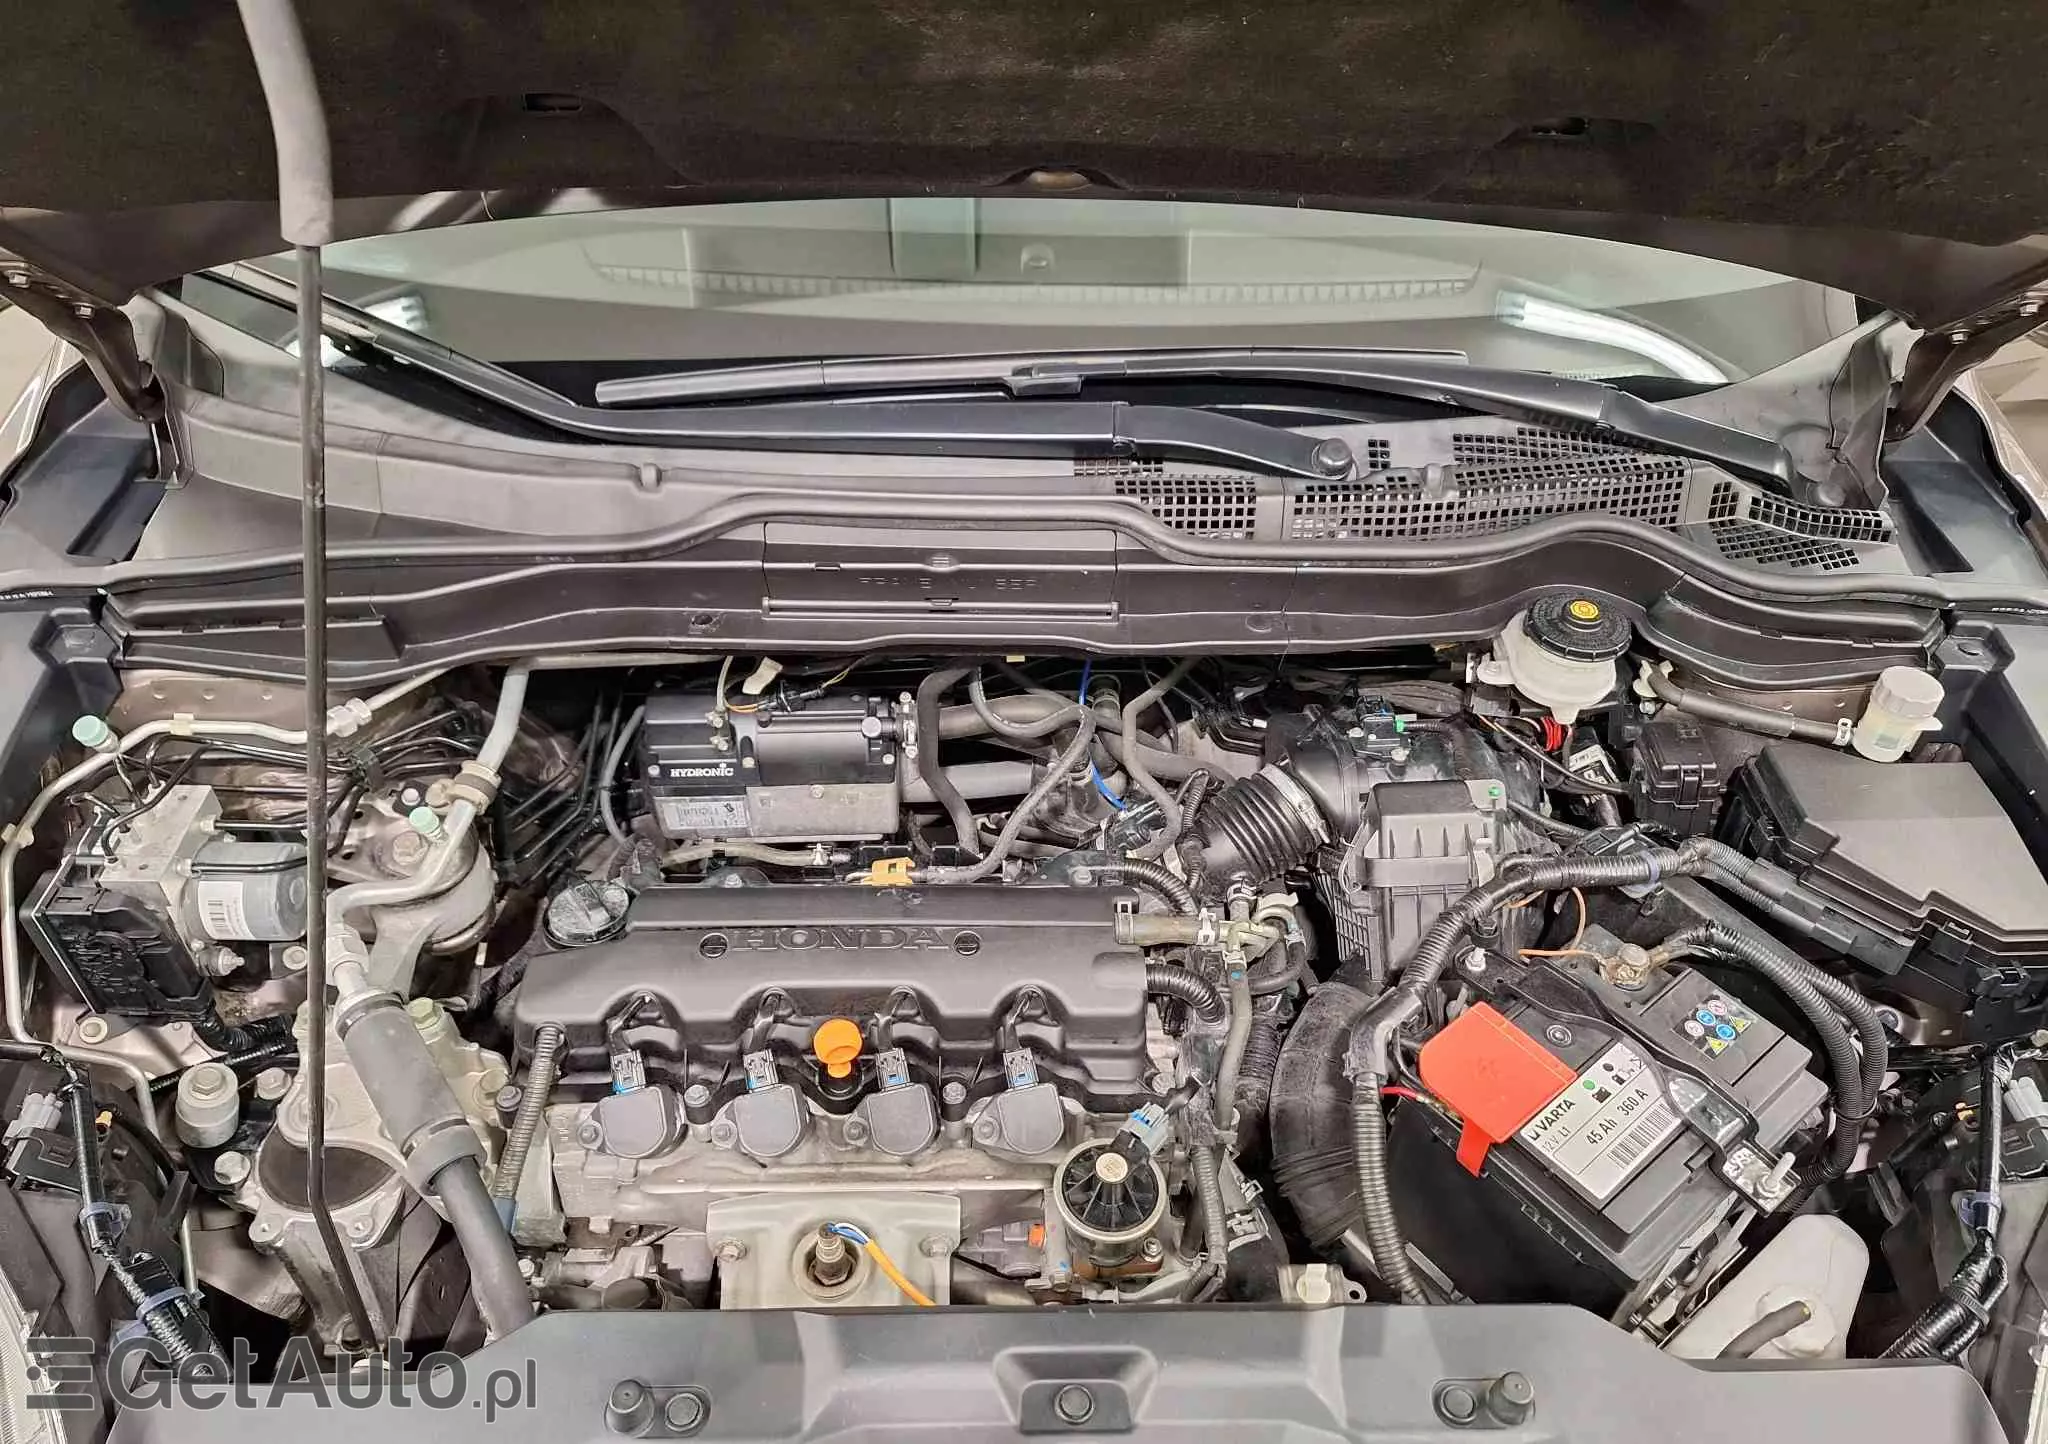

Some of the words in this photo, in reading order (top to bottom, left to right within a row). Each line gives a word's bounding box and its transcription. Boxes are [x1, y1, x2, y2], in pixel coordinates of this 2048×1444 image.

[670, 763, 734, 777] HYDRONIC
[732, 928, 950, 951] HONDA
[1536, 1098, 1576, 1131] VARTA
[1586, 1131, 1603, 1145] 45
[1600, 1117, 1618, 1136] Ah
[1617, 1096, 1639, 1116] 360
[1635, 1088, 1649, 1101] A
